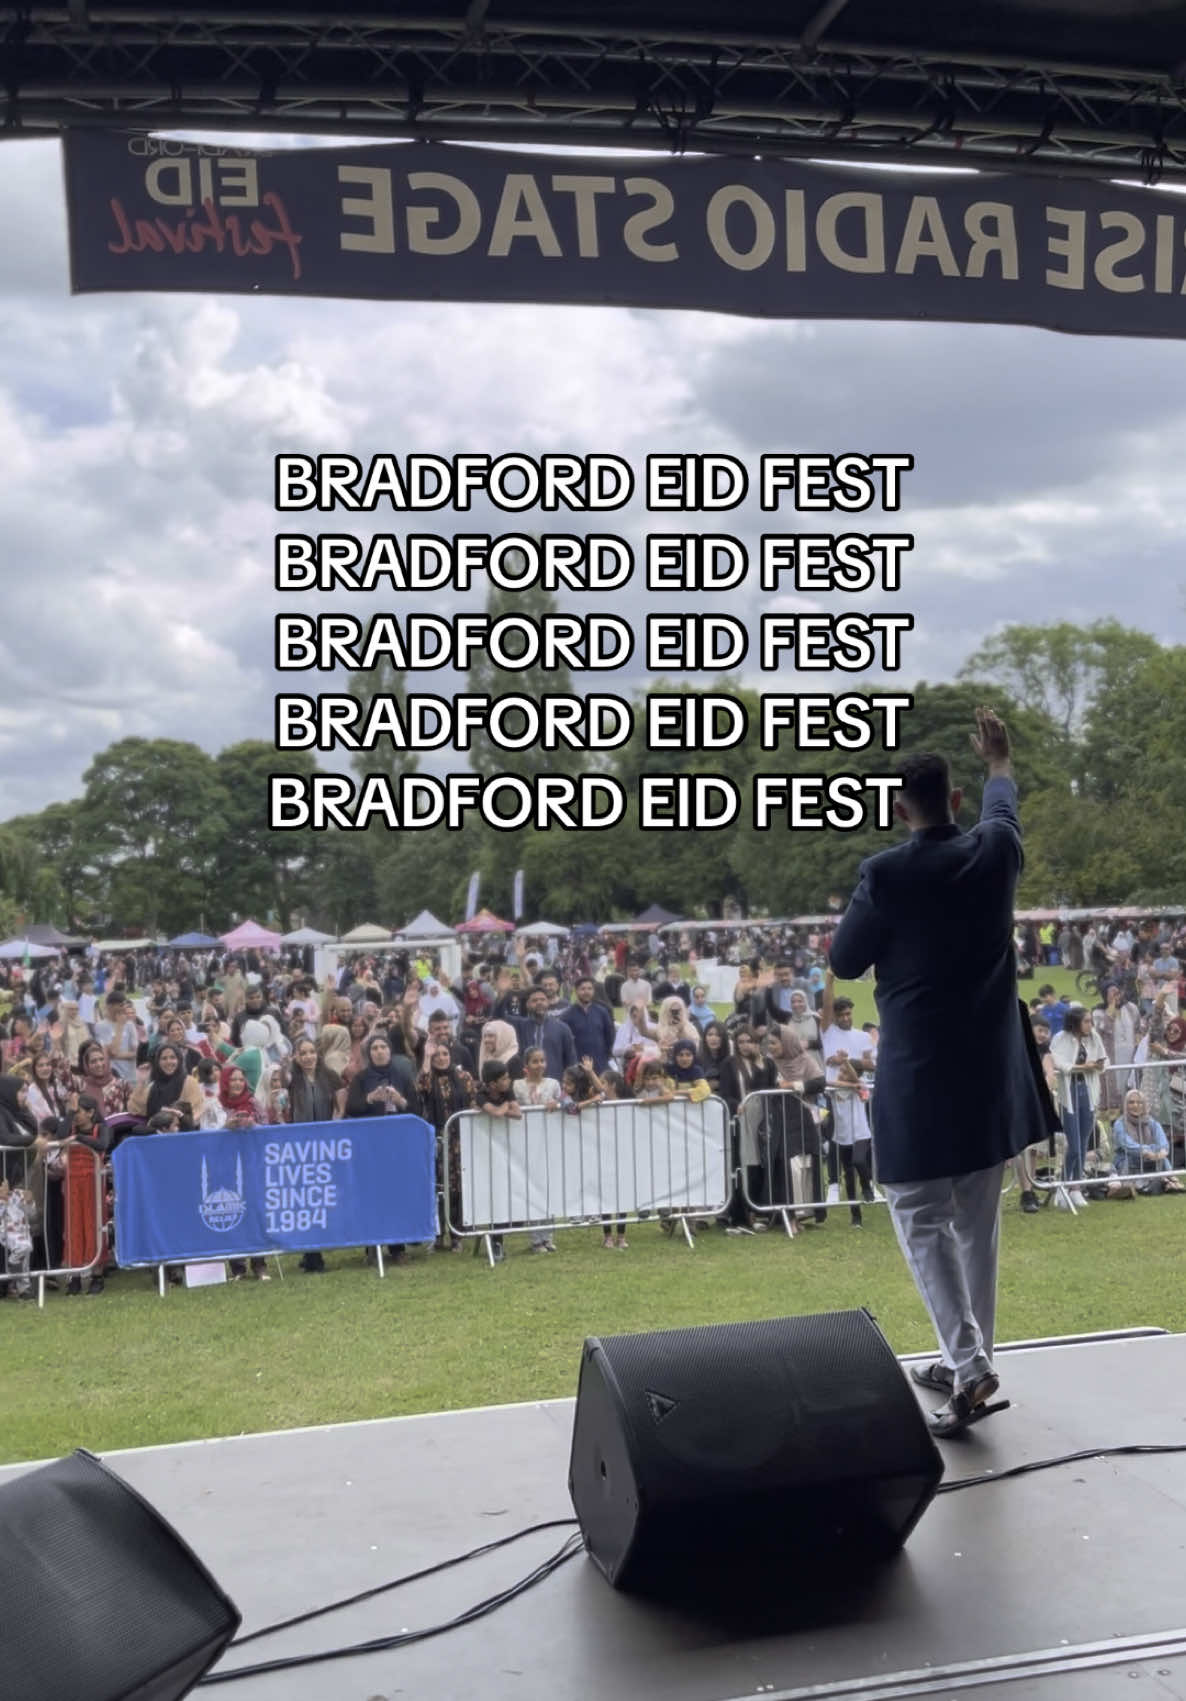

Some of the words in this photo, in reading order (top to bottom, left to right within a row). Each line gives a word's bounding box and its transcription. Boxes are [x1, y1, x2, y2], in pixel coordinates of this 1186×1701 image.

[265, 1138, 352, 1165] SAVING
[265, 1163, 332, 1188] LIVES
[265, 1184, 337, 1211] SINCE
[265, 1208, 328, 1234] 1984
